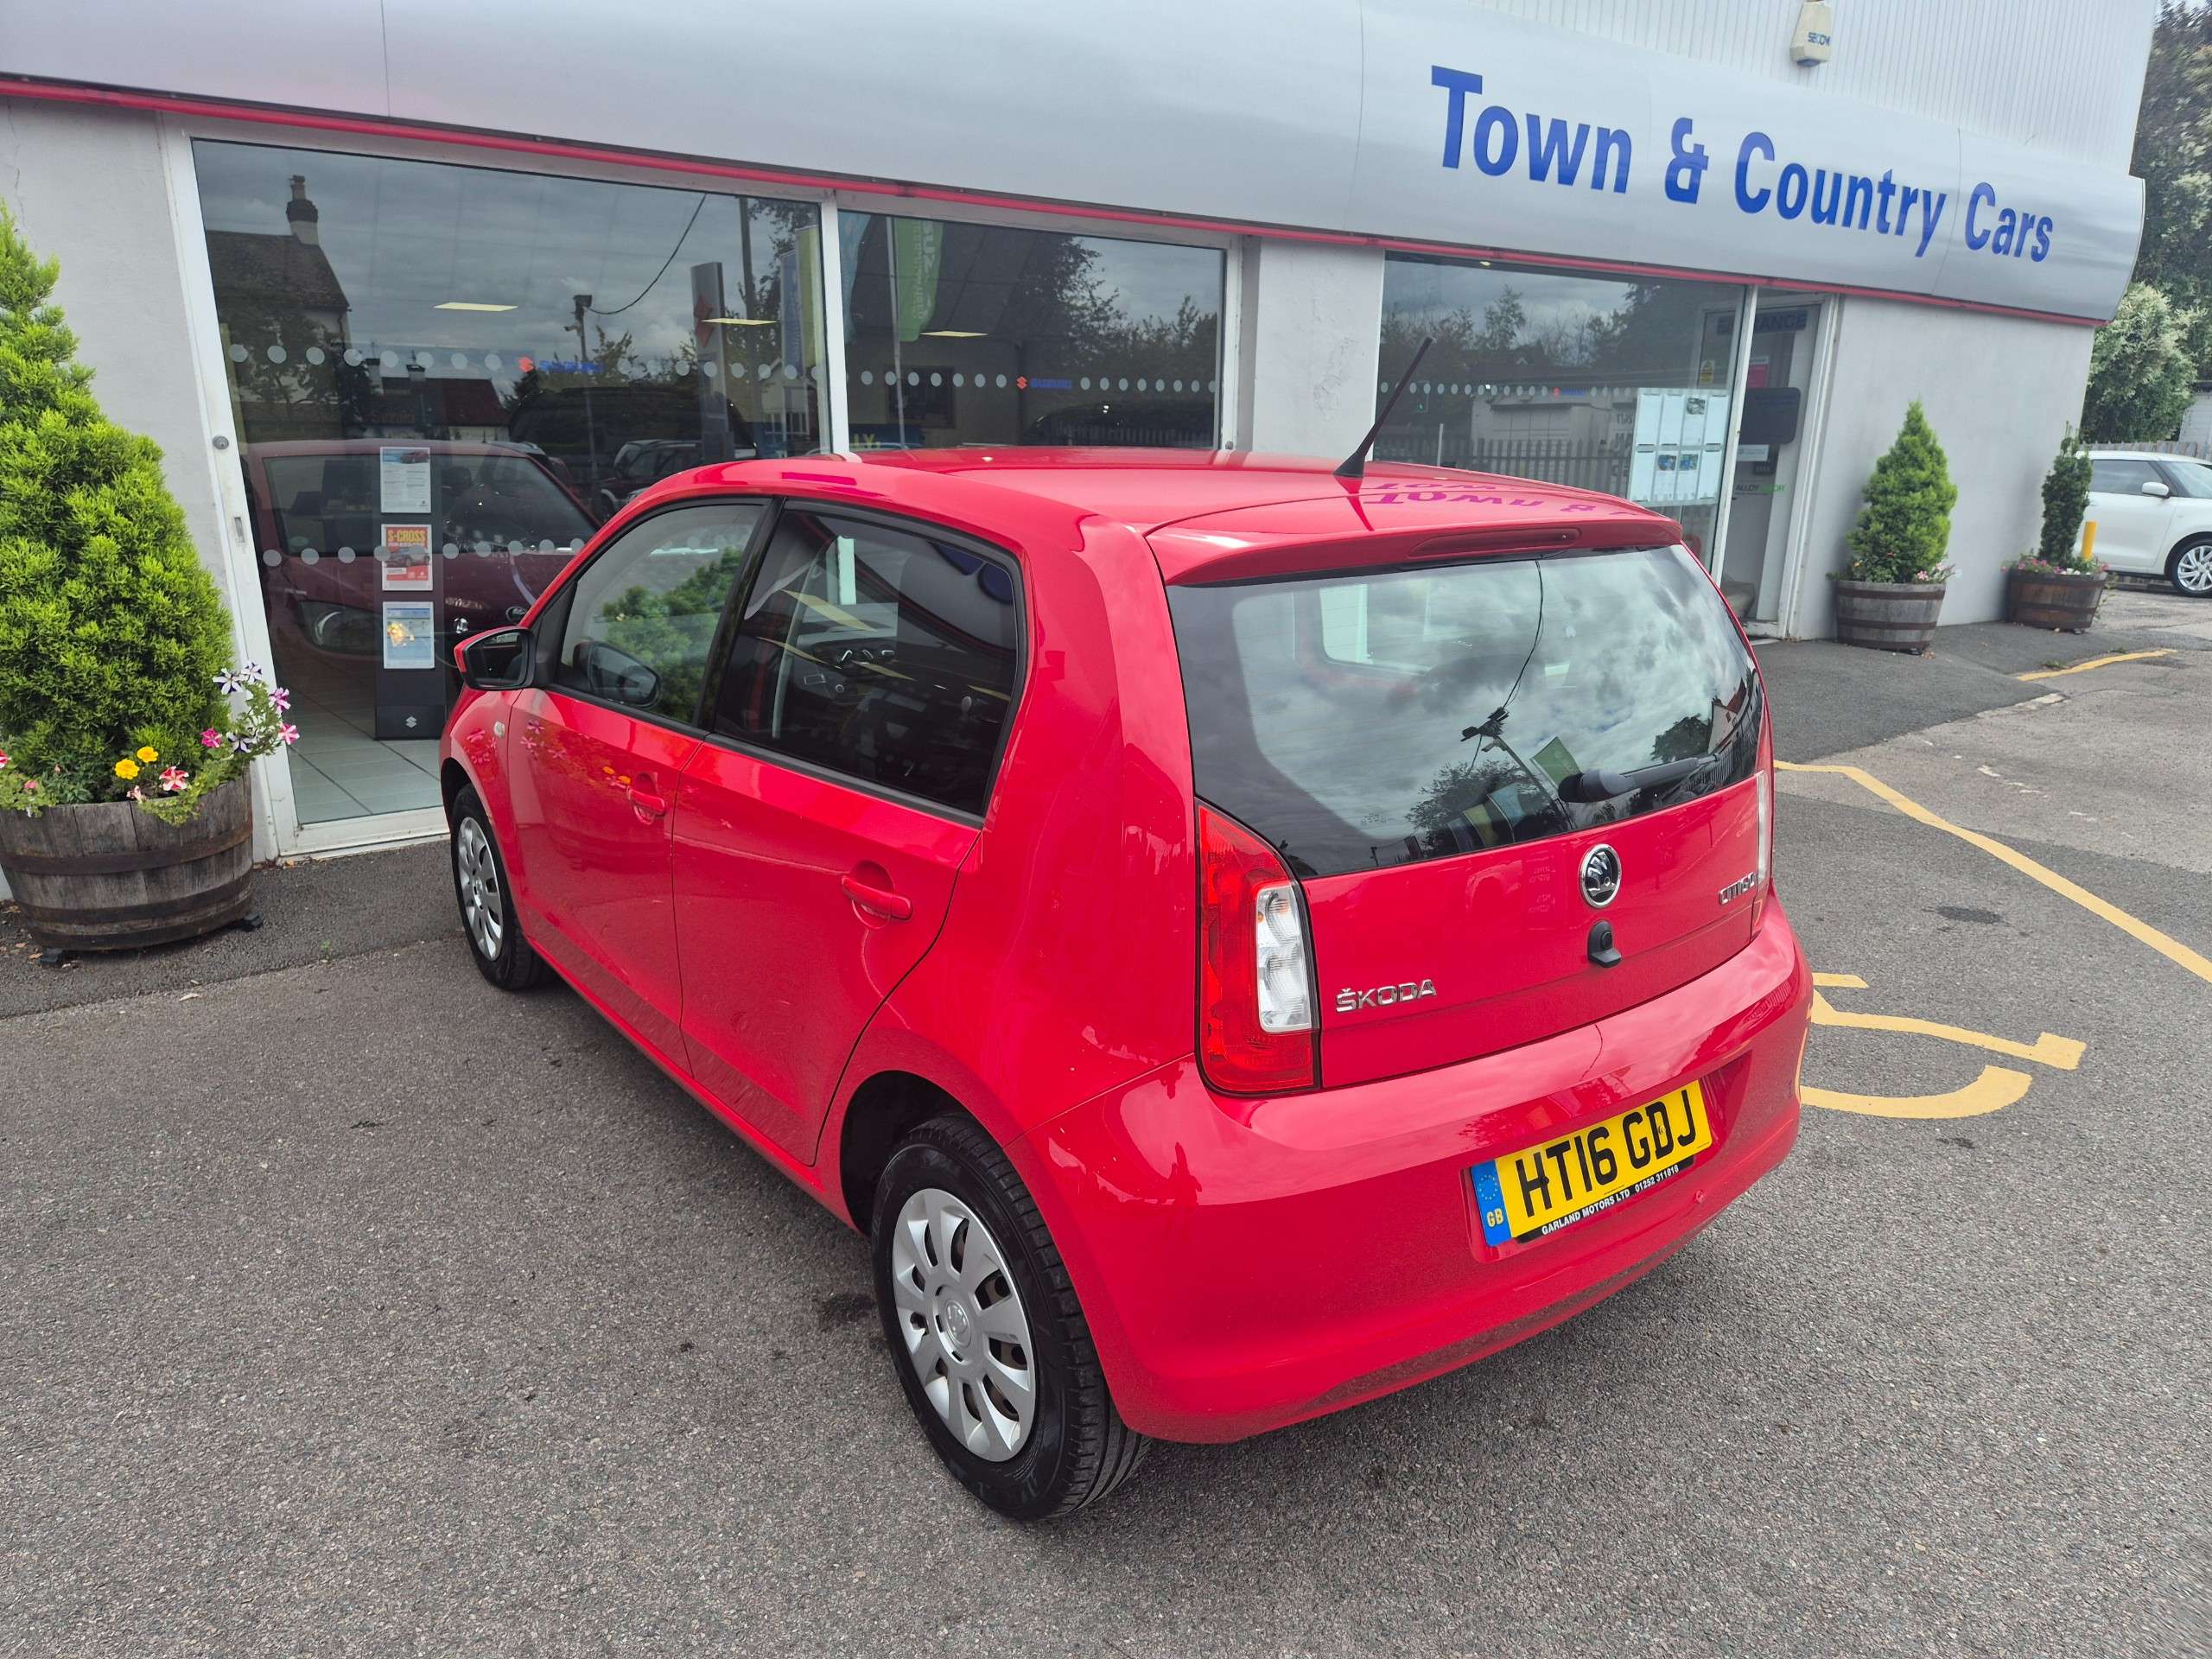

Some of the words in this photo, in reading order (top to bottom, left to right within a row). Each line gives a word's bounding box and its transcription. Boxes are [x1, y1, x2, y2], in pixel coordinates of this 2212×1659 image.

[1431, 65, 1632, 194] Town
[1664, 118, 1709, 204] &
[1735, 131, 1948, 257] Country
[1965, 181, 2053, 263] Cars
[1718, 311, 1807, 336] EANCE
[388, 531, 425, 543] S-CROSS
[1336, 979, 1437, 1013] ŠKODA
[1516, 1126, 1618, 1218] HT16
[1622, 1089, 1697, 1170] GDJ
[1486, 1208, 1503, 1228] GB
[1541, 1211, 1580, 1236] GARLAND
[1582, 1196, 1615, 1217] MOTORS
[1616, 1188, 1630, 1204] LTD
[1635, 1177, 1655, 1192] 01252
